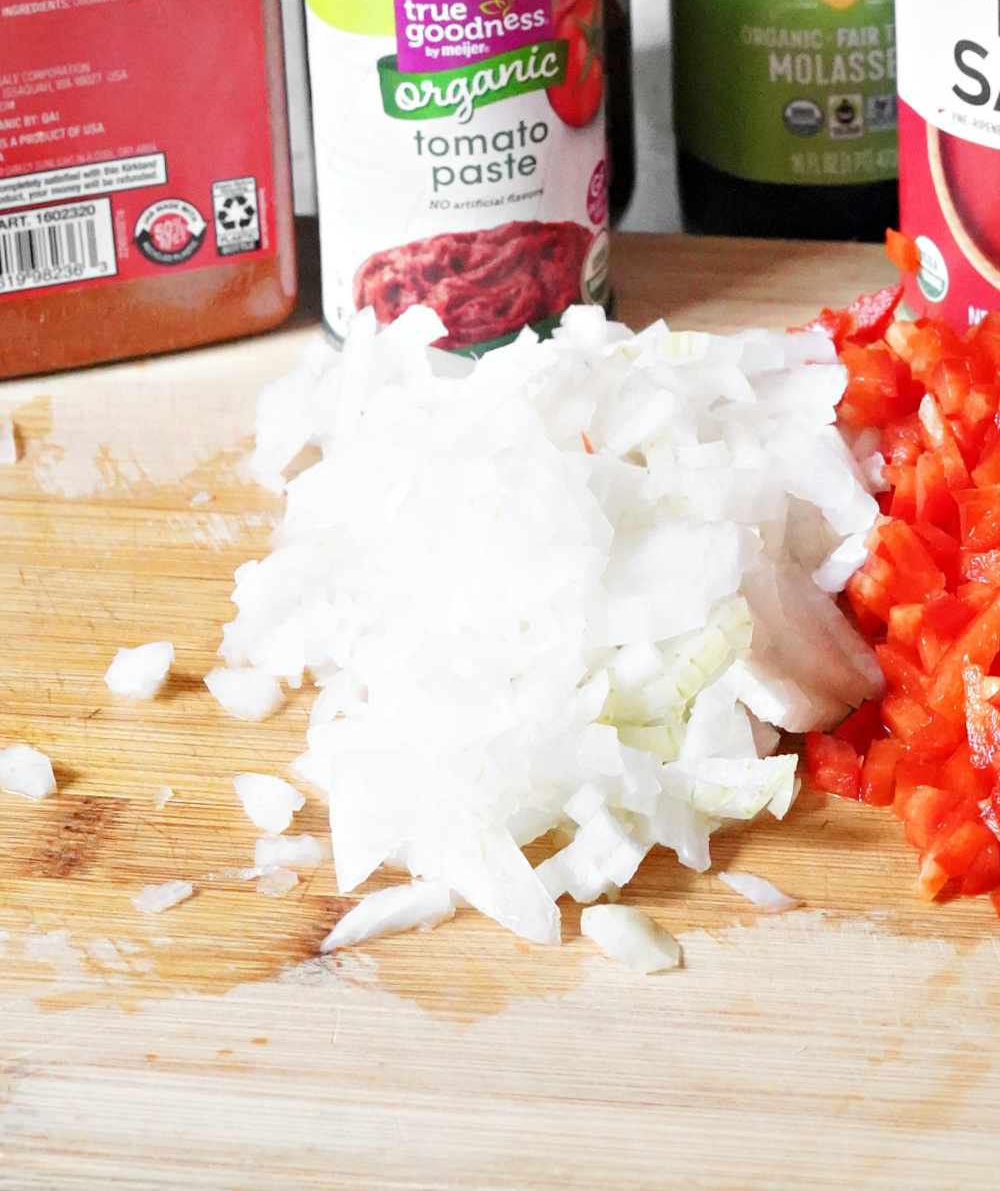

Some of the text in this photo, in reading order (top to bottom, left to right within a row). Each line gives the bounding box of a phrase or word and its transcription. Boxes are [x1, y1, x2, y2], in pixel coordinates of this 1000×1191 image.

[405, 8, 546, 48] goodness
[425, 41, 486, 59] by meijer
[413, 120, 549, 157] tomato
[431, 153, 537, 192] paste
[35, 204, 96, 225] 1602320
[429, 199, 450, 211] NO
[453, 196, 504, 210] artificial
